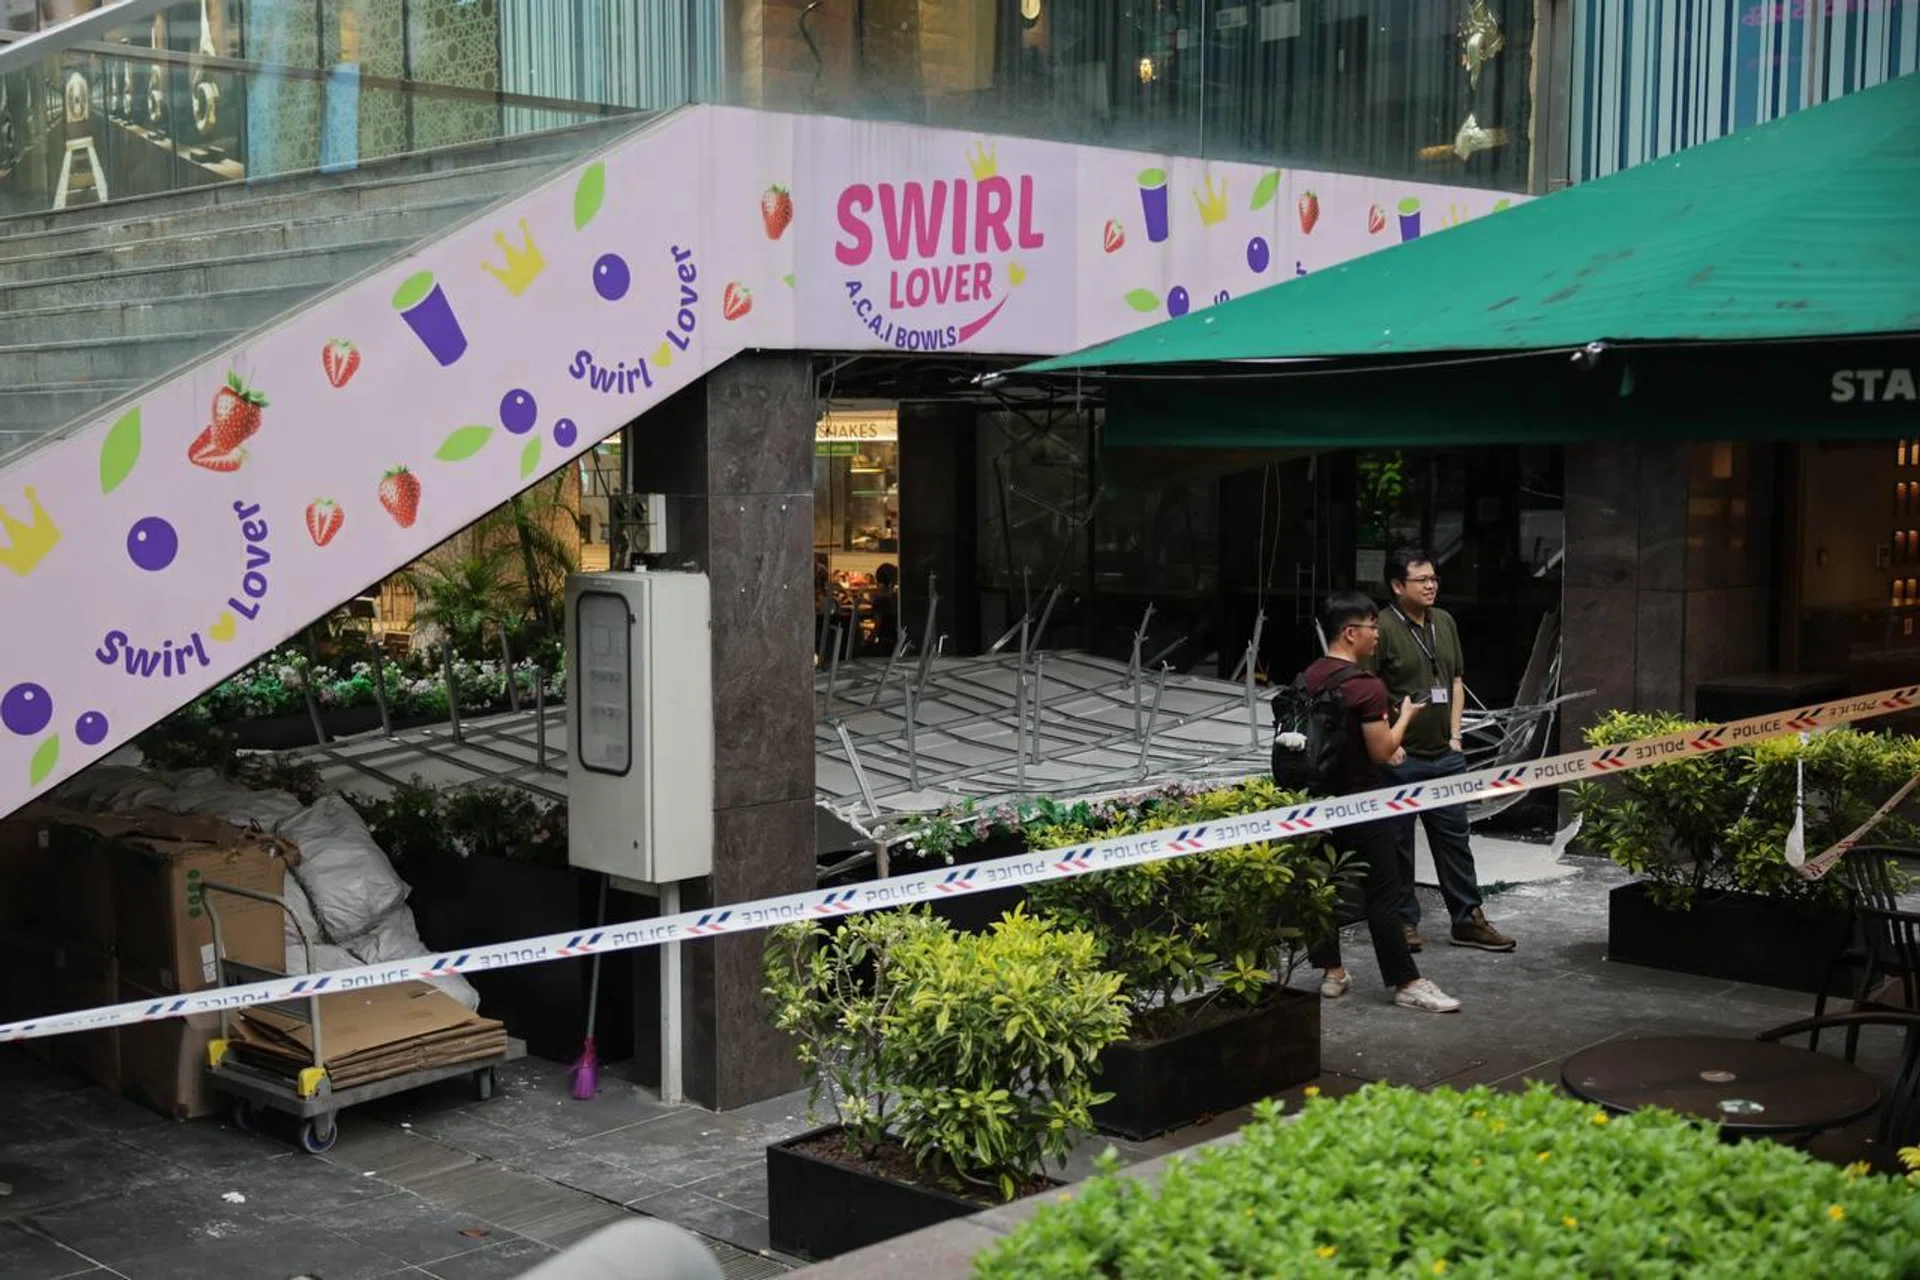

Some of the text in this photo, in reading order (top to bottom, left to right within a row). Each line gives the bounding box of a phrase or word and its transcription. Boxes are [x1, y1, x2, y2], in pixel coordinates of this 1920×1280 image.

[835, 175, 1044, 266] SWIRL
[889, 262, 992, 309] LOVER
[568, 245, 698, 394] Swirl Lover
[895, 325, 957, 350] BOWLS
[818, 423, 878, 438] SHAKES
[95, 500, 271, 677] Swirl Lover
[1732, 720, 1781, 739] POLICE
[1635, 739, 1685, 759] POLICE
[1534, 759, 1586, 779] POLICE
[1432, 780, 1484, 799] POLICE
[1325, 799, 1379, 819] POLICE
[1216, 819, 1272, 840] POLICE
[1103, 840, 1160, 860] POLICE
[987, 860, 1045, 880] POLICE
[866, 882, 925, 902] POLICE
[742, 903, 804, 925] POLICE
[612, 924, 677, 946] POLICE
